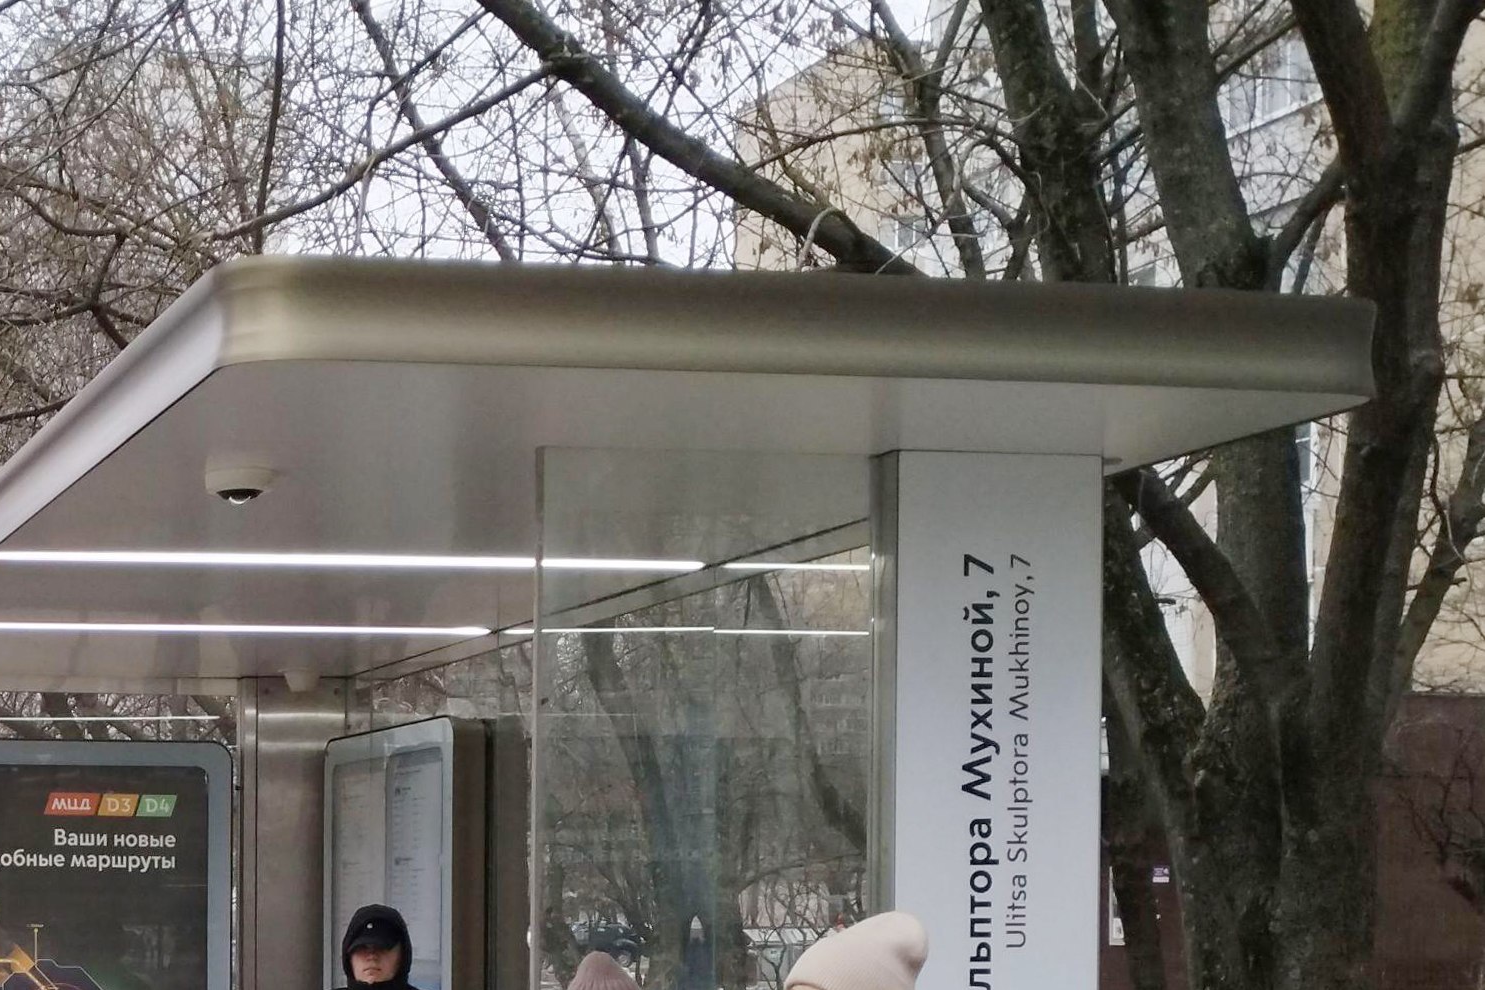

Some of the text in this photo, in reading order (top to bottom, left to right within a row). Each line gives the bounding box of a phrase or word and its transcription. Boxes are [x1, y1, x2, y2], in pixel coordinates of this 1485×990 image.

[963, 553, 995, 577] 7
[1008, 575, 1035, 721] Mukhinoy,
[961, 590, 1001, 801] Мухиной,
[51, 797, 91, 811] МЦД
[1007, 733, 1033, 863] Skulptora
[54, 828, 177, 848] Ваши новые
[70, 855, 176, 873] маршруты
[1005, 874, 1027, 948] Ulitsa
